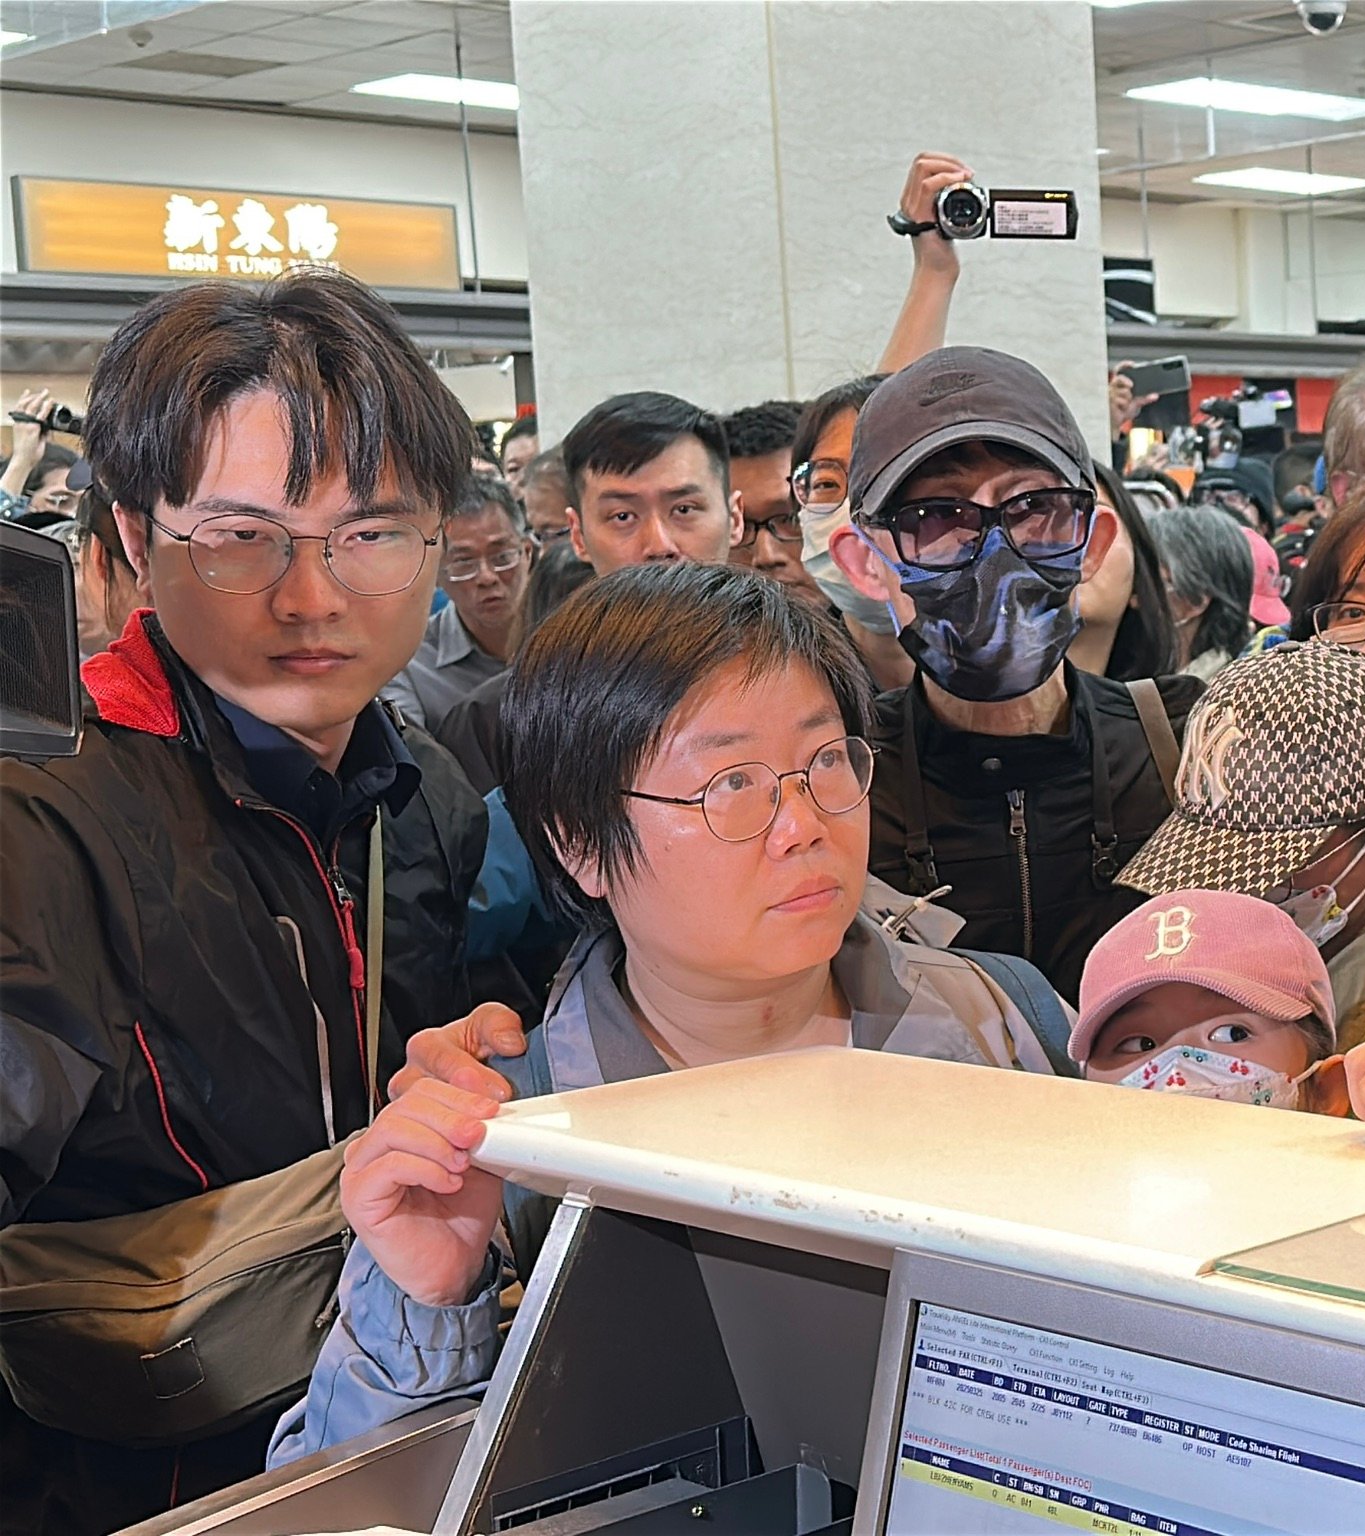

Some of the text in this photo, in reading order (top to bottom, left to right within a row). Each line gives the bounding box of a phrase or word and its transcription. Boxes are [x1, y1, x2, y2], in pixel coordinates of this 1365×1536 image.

[168, 253, 218, 272] HSIN
[225, 255, 284, 275] TUNG
[1145, 905, 1197, 961] B
[927, 1340, 955, 1357] Selected
[1104, 1365, 1114, 1378] Log
[1120, 1370, 1134, 1383] Help
[1081, 1380, 1096, 1392] Seat
[958, 1366, 975, 1379] DATE
[1013, 1380, 1026, 1392] ETD
[1033, 1385, 1045, 1397] ETA
[1053, 1390, 1079, 1406] LAYOUT
[1088, 1399, 1106, 1413] GATE
[1111, 1405, 1128, 1419] TYPE
[1144, 1413, 1179, 1432] REGISTER
[1184, 1424, 1194, 1436] ST
[1198, 1427, 1220, 1443] MODE
[1228, 1435, 1246, 1450] Code
[1249, 1441, 1276, 1459] Sharing
[1278, 1448, 1299, 1465] Flight
[997, 1412, 1011, 1425] USE
[904, 1429, 932, 1445] Selected
[934, 1437, 968, 1457] Passenger
[1182, 1440, 1193, 1452] OP
[1196, 1444, 1216, 1459] HOST
[931, 1454, 950, 1469] NAME
[1008, 1476, 1018, 1488] ST
[1049, 1487, 1060, 1500] SN
[1071, 1494, 1086, 1508] GRP
[1094, 1500, 1109, 1515] PNR
[1130, 1511, 1146, 1526] BAG
[1159, 1519, 1177, 1534] ITEM
[1006, 1492, 1016, 1504] AC
